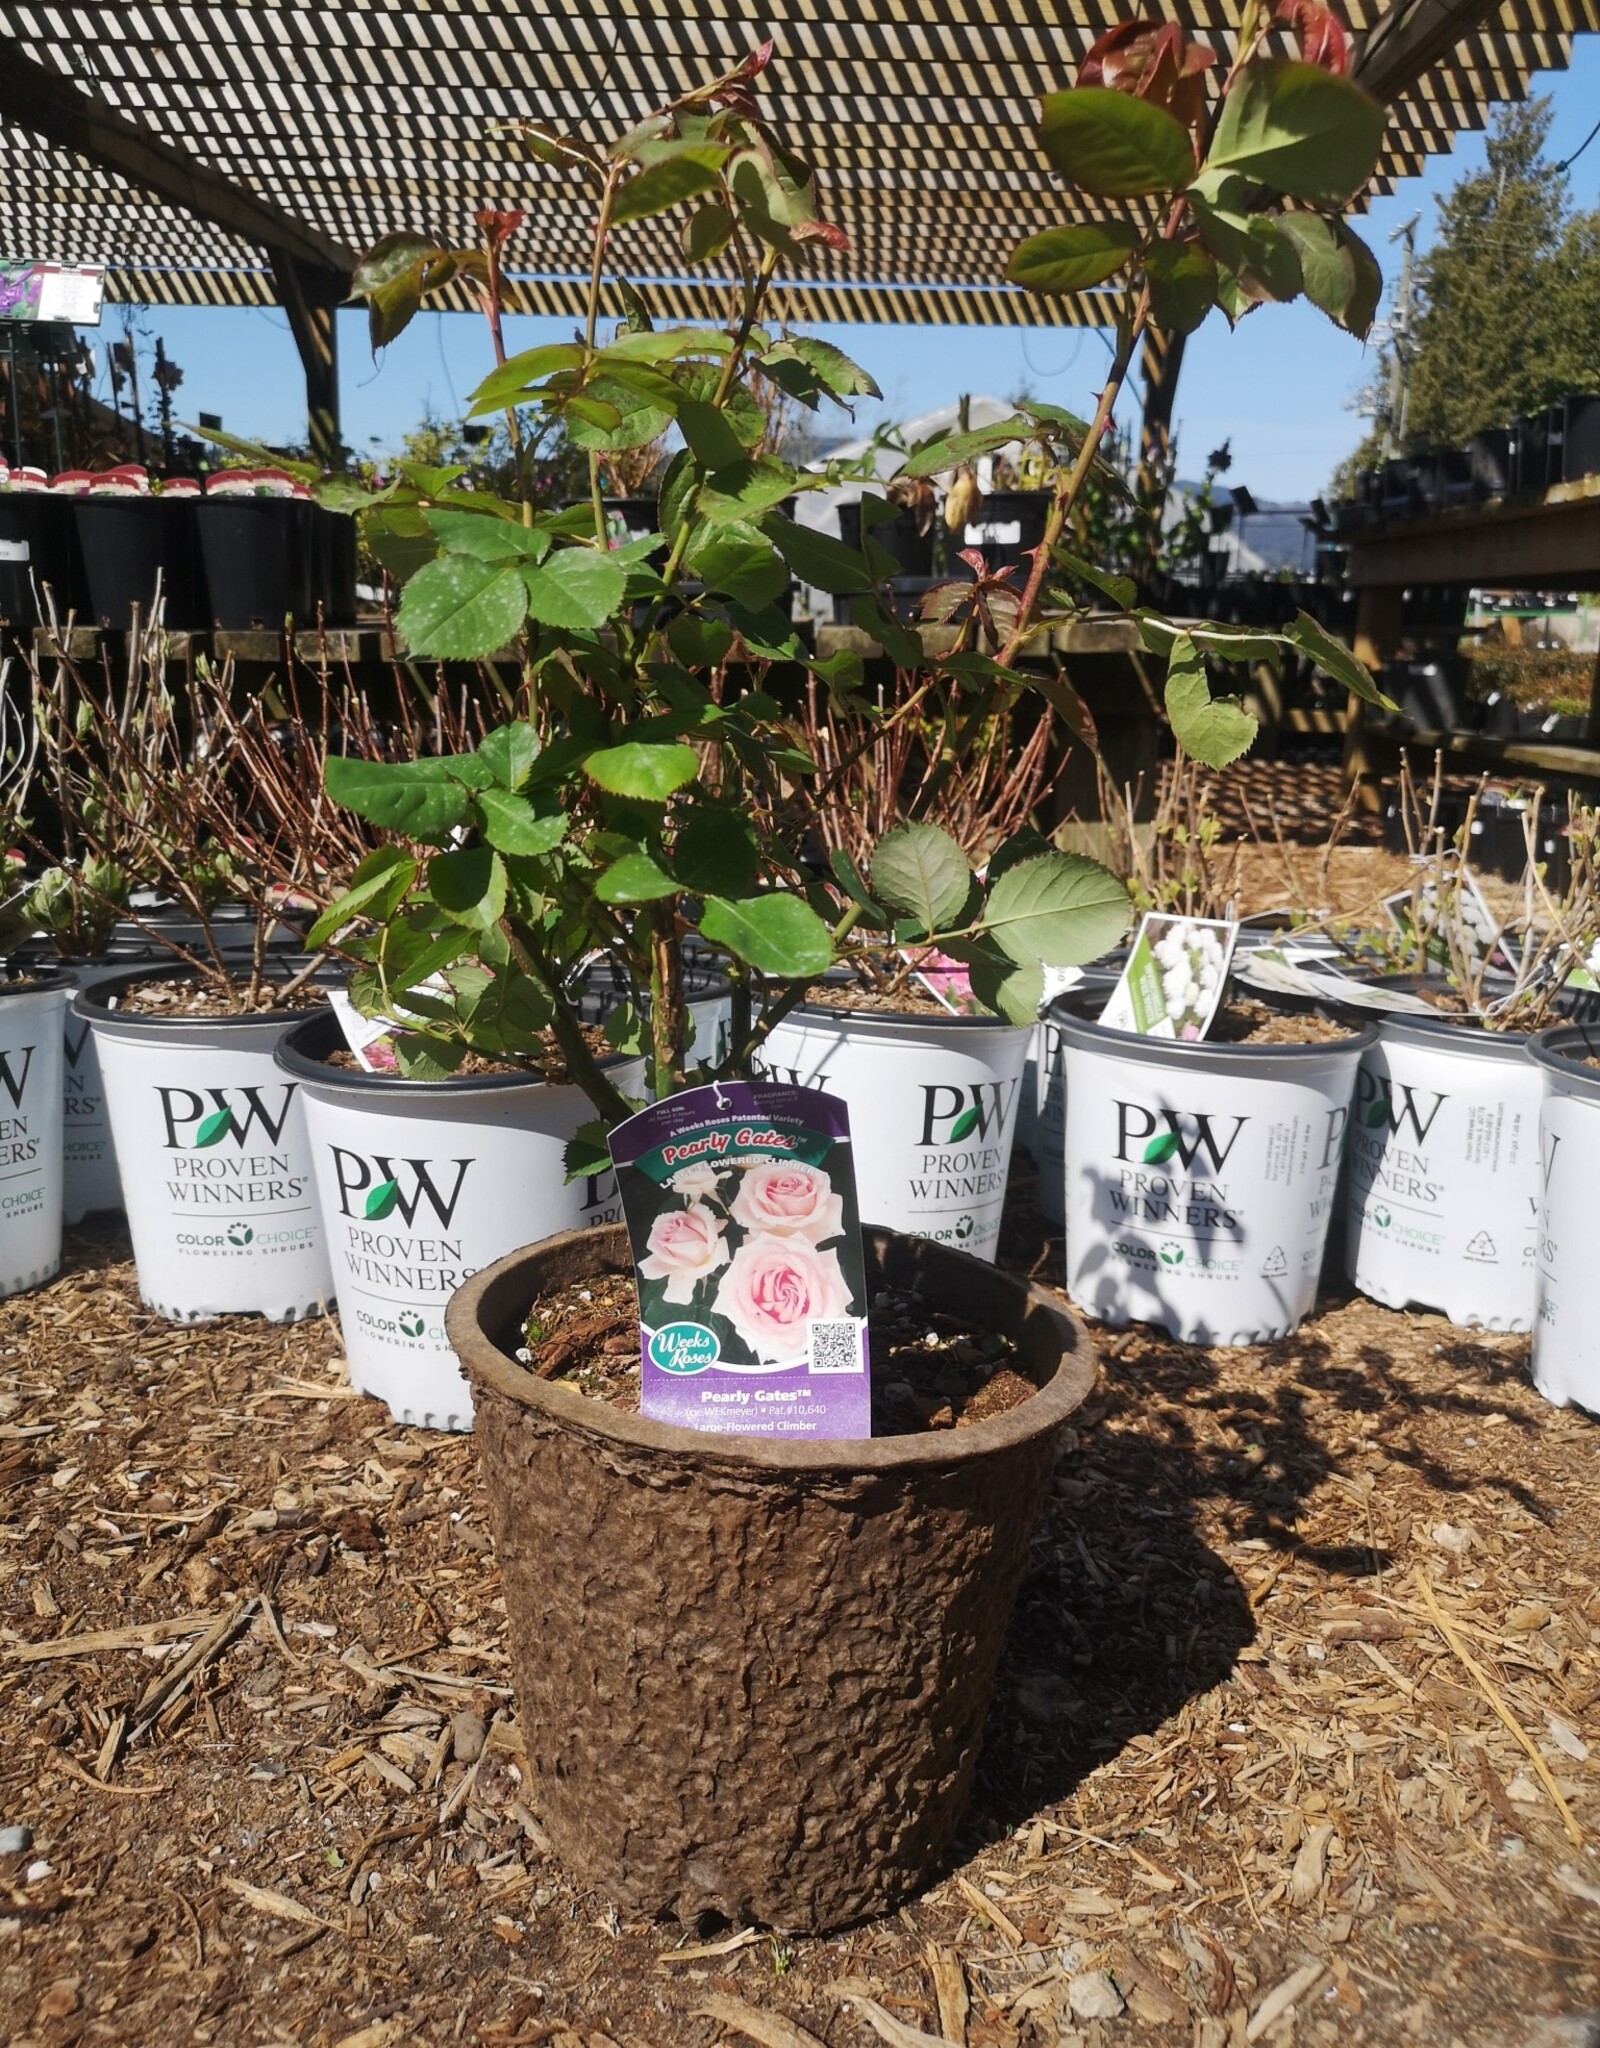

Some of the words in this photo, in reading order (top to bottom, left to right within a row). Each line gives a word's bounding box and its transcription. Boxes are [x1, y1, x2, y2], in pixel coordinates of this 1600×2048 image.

[152, 1082, 300, 1150] PW
[669, 1130, 677, 1138] A
[676, 1121, 705, 1134] Weeks
[705, 1115, 730, 1126] Roses
[731, 1113, 771, 1122] Patented
[773, 1114, 805, 1126] Variety
[662, 1131, 731, 1165] Pearly
[1111, 1099, 1252, 1175] PW
[173, 1153, 290, 1180] PROVEN
[765, 1157, 819, 1176] CLIMBER
[922, 1146, 1003, 1174] PROVEN
[327, 1143, 477, 1230] PW
[1119, 1168, 1229, 1203] PROVEN
[176, 1233, 225, 1247] COLOR
[178, 1248, 253, 1257] FLOWERING
[262, 1242, 314, 1254] SHRUBS
[348, 1226, 463, 1262] PROVEN
[1112, 1241, 1156, 1261] COLOR
[356, 1309, 398, 1334] COLOR
[358, 1327, 426, 1351] FLOWERING
[657, 1331, 710, 1354] Weeks
[669, 1348, 712, 1370] Roses
[701, 1390, 750, 1405] Pearly
[776, 1420, 817, 1431] Climber
